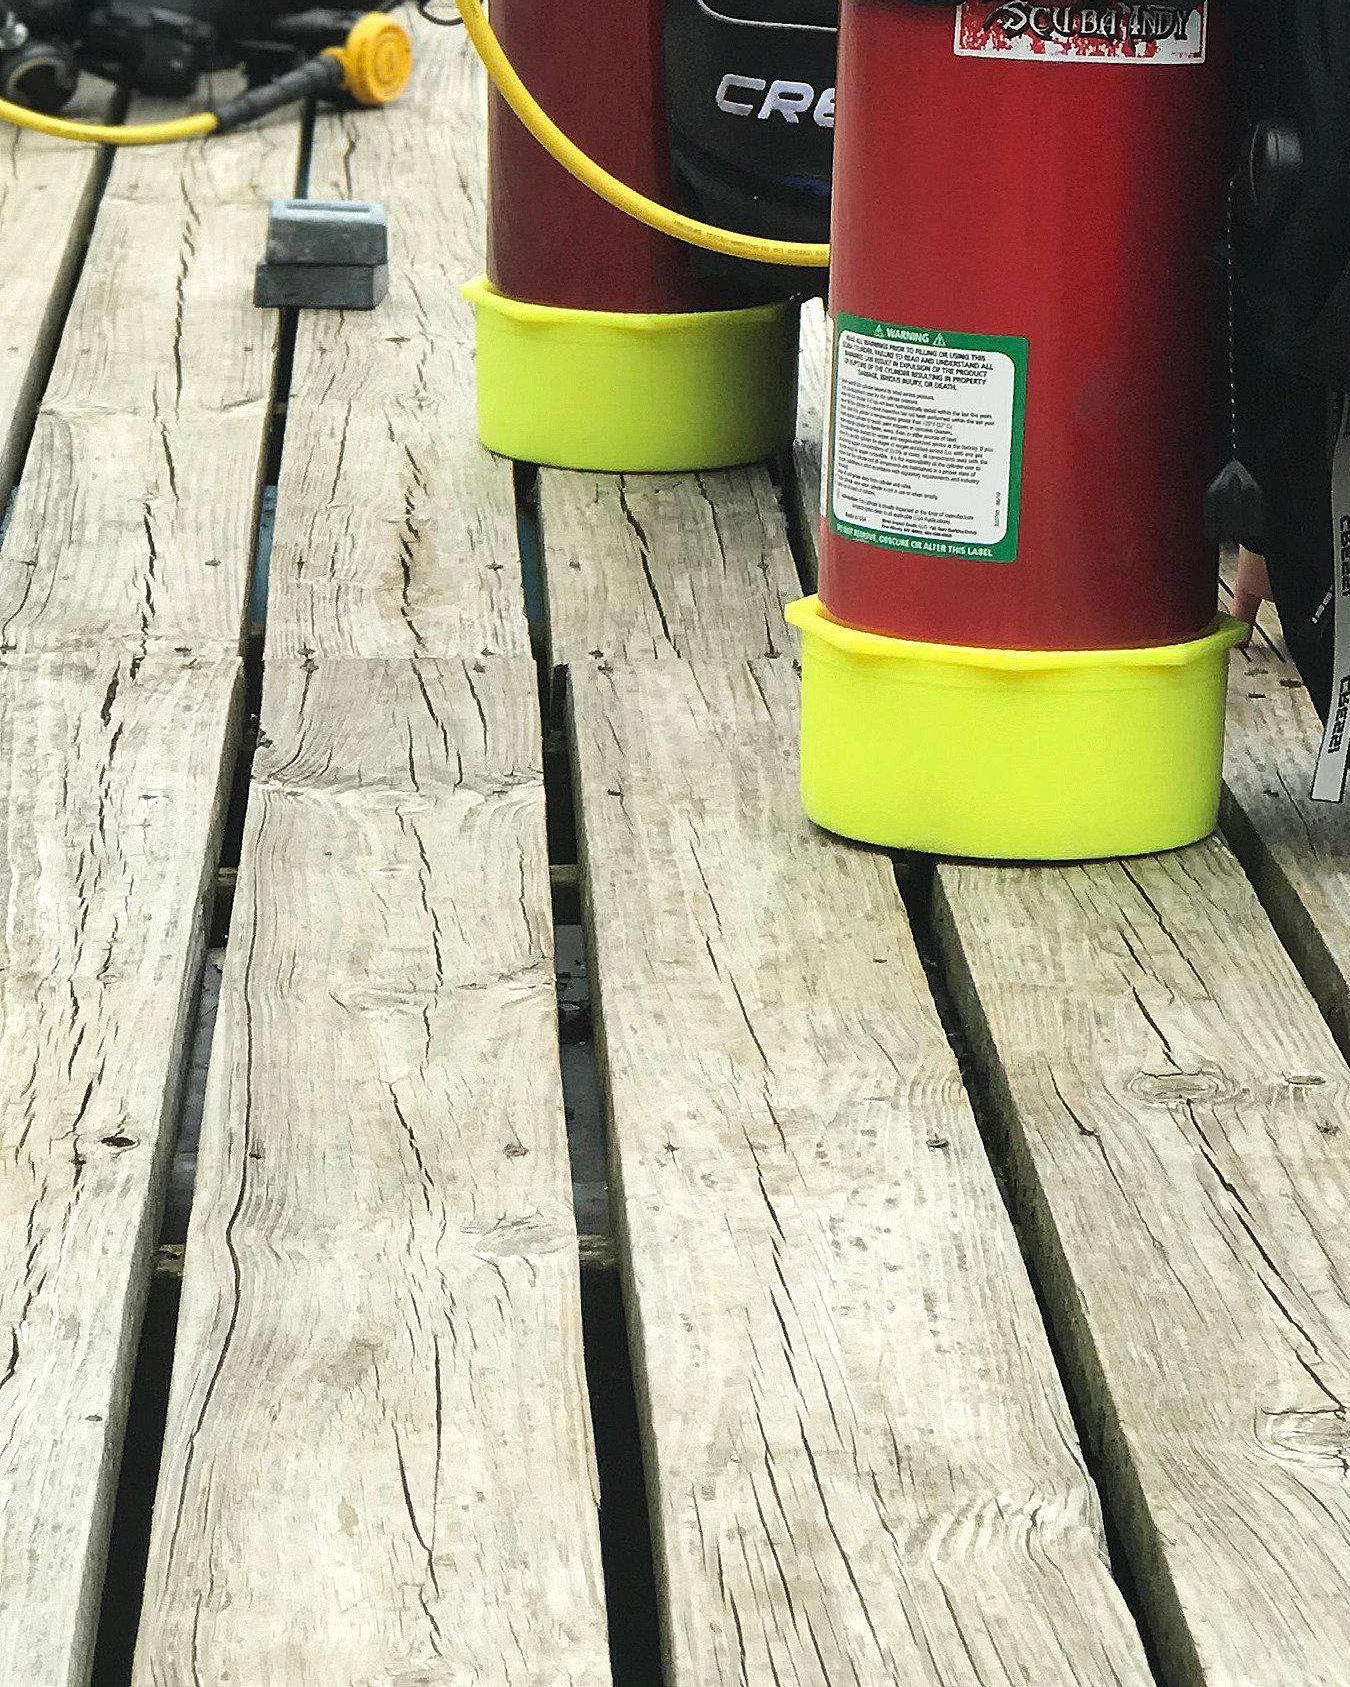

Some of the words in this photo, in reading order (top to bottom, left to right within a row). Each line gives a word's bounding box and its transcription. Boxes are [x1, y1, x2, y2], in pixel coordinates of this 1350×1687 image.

[1129, 4, 1191, 39] INDY
[886, 327, 930, 343] WARNING
[971, 354, 985, 362] THIS
[981, 363, 994, 371] ALL
[955, 369, 987, 378] PRODUCT
[952, 377, 986, 386] PROPERTY
[911, 540, 923, 550] OR
[923, 542, 947, 553] ALTER
[948, 545, 966, 556] THIS
[968, 547, 993, 557] LABEL
